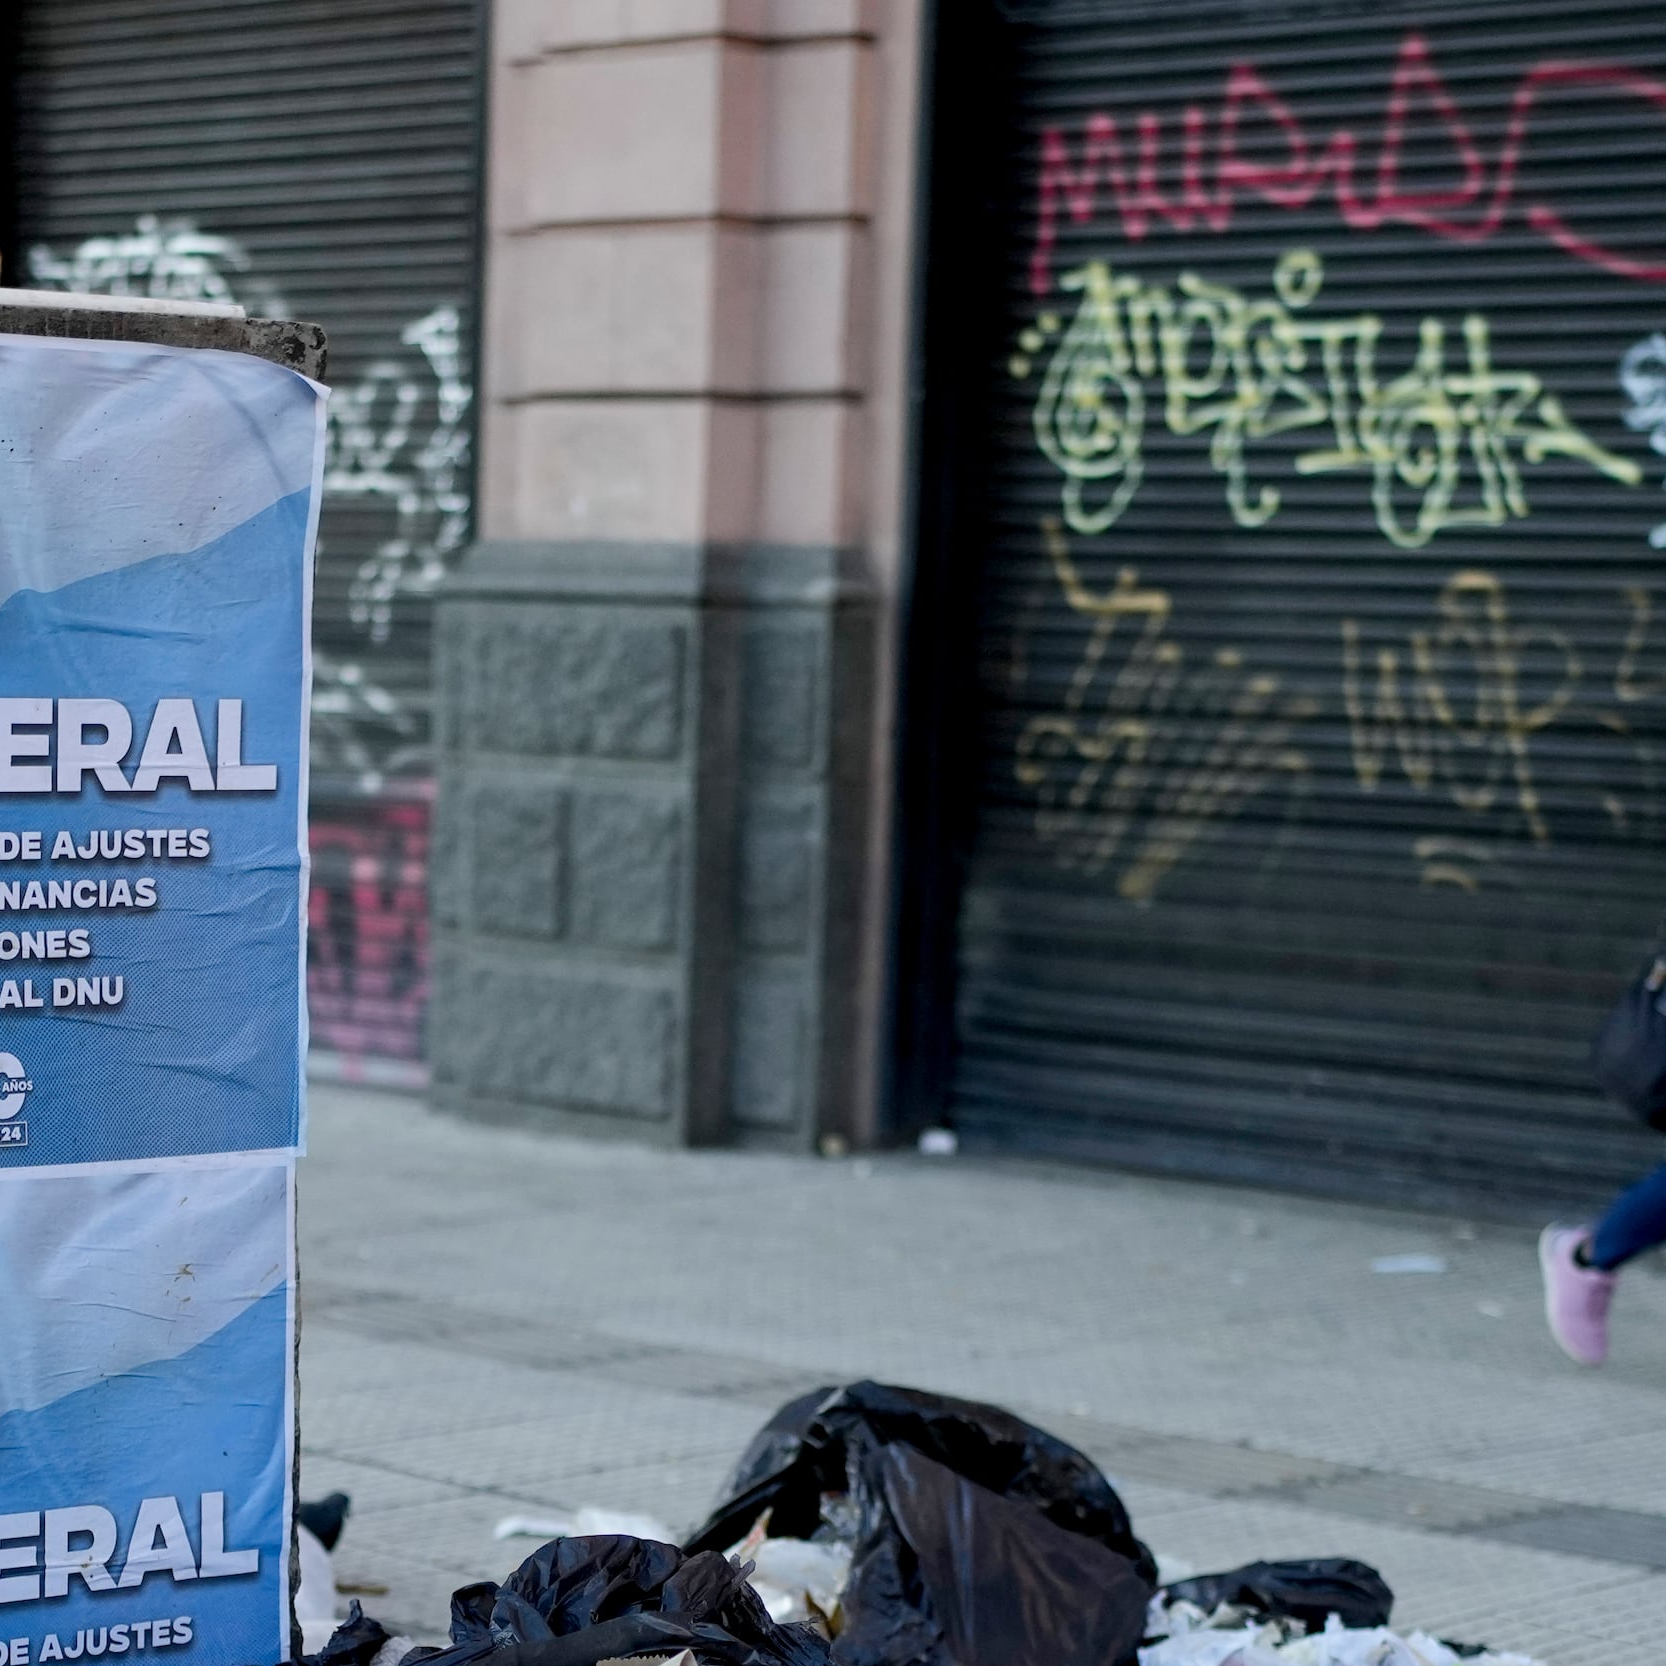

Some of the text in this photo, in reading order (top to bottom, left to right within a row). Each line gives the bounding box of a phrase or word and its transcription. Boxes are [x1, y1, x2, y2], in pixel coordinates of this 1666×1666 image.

[52, 828, 211, 860] AJUSTES
[52, 975, 125, 1007] DNU
[2, 1080, 33, 1093] AÑOS
[40, 1616, 193, 1666] AJUSTES
